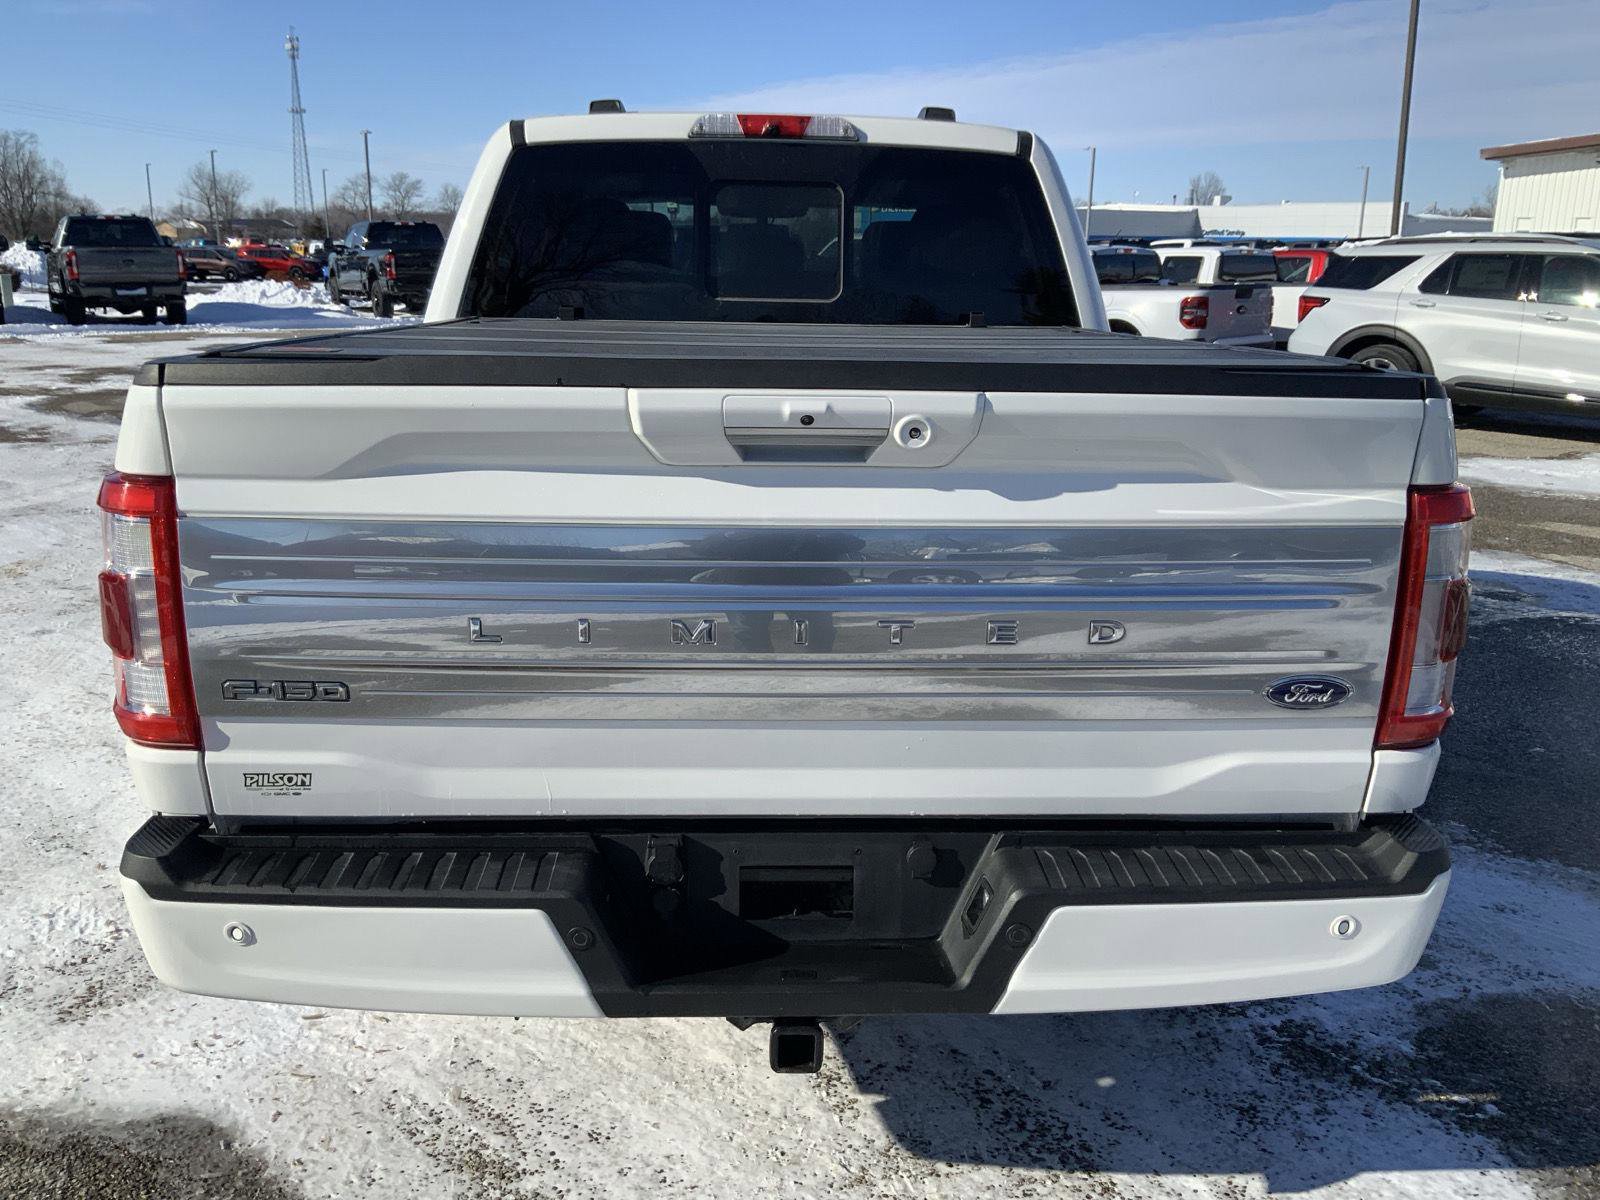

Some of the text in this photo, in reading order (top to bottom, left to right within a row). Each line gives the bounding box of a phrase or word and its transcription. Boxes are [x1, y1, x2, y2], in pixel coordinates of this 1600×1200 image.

[468, 616, 1126, 646] LIMITED
[221, 678, 350, 702] F-150
[1284, 683, 1334, 703] Ford
[243, 773, 312, 787] PILSON
